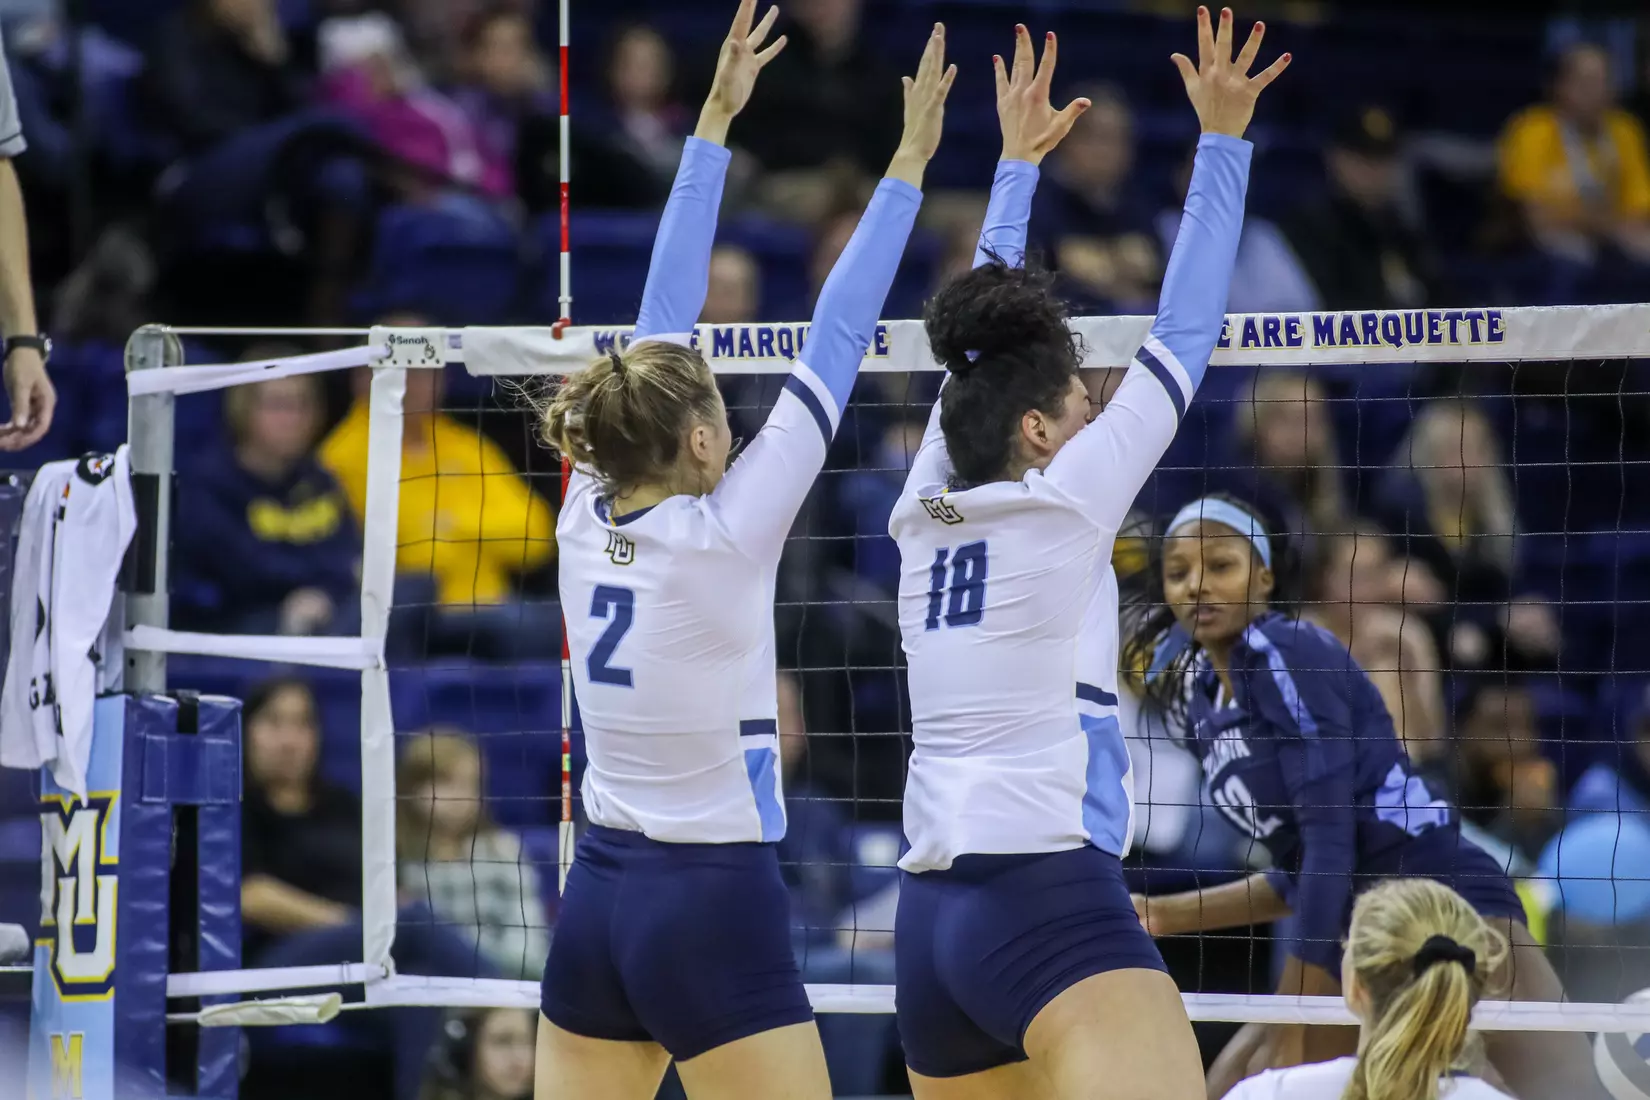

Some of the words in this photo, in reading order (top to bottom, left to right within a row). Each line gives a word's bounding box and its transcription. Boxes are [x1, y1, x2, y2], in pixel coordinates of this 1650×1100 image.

[711, 325, 889, 362] MARQE
[1216, 314, 1234, 350] E
[1240, 314, 1305, 350] ARE
[1311, 309, 1506, 350] MARQUETTE
[919, 496, 964, 525] MU
[604, 530, 635, 566] MU
[924, 538, 989, 632] 18
[585, 583, 635, 689] 2
[38, 799, 118, 994] MU
